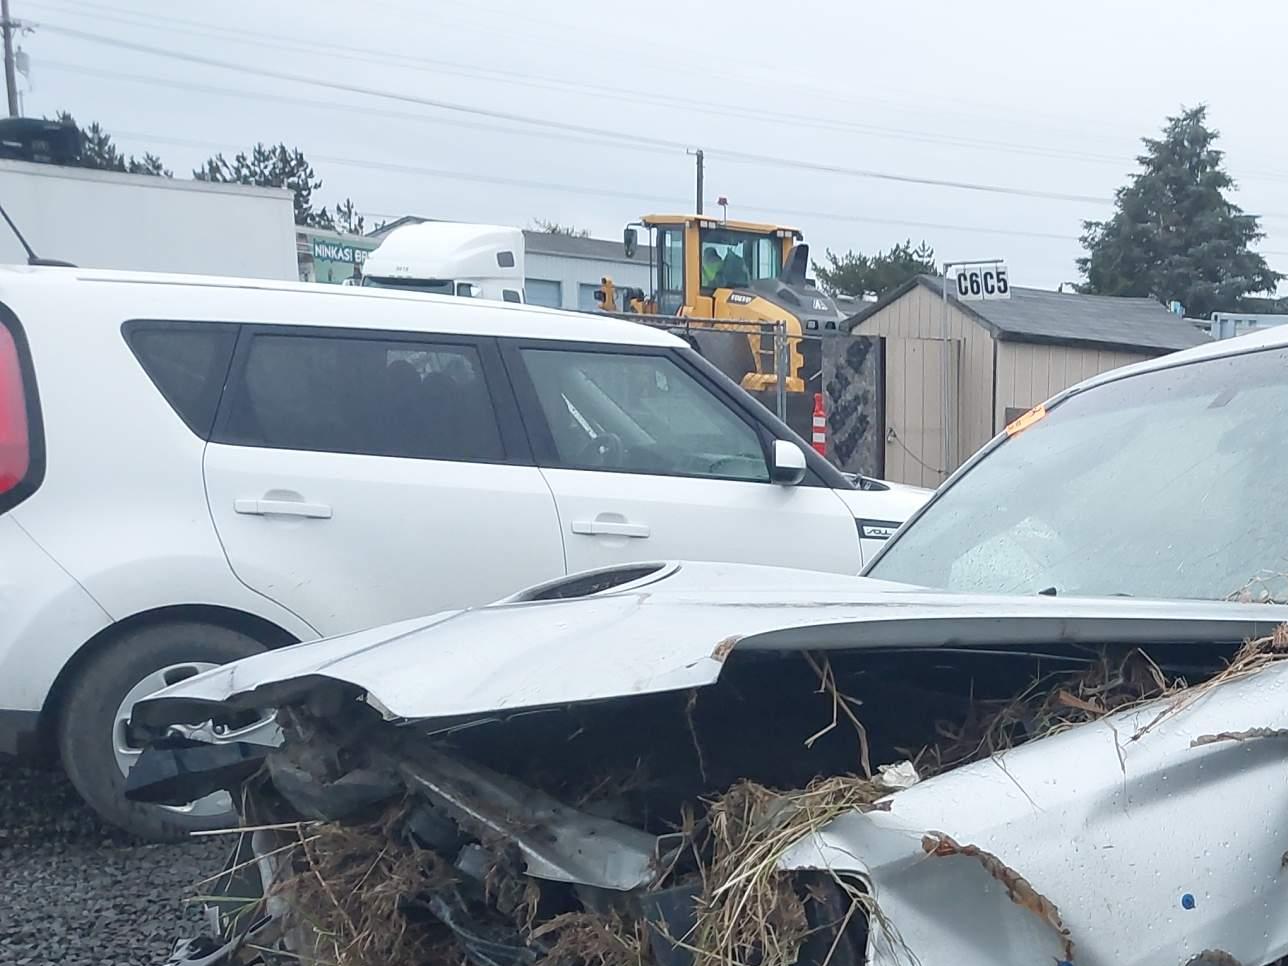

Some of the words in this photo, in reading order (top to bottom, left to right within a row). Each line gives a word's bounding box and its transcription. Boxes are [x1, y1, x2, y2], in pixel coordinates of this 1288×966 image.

[315, 243, 353, 262] NINKASI
[957, 272, 981, 296] C6
[983, 271, 1008, 295] C5
